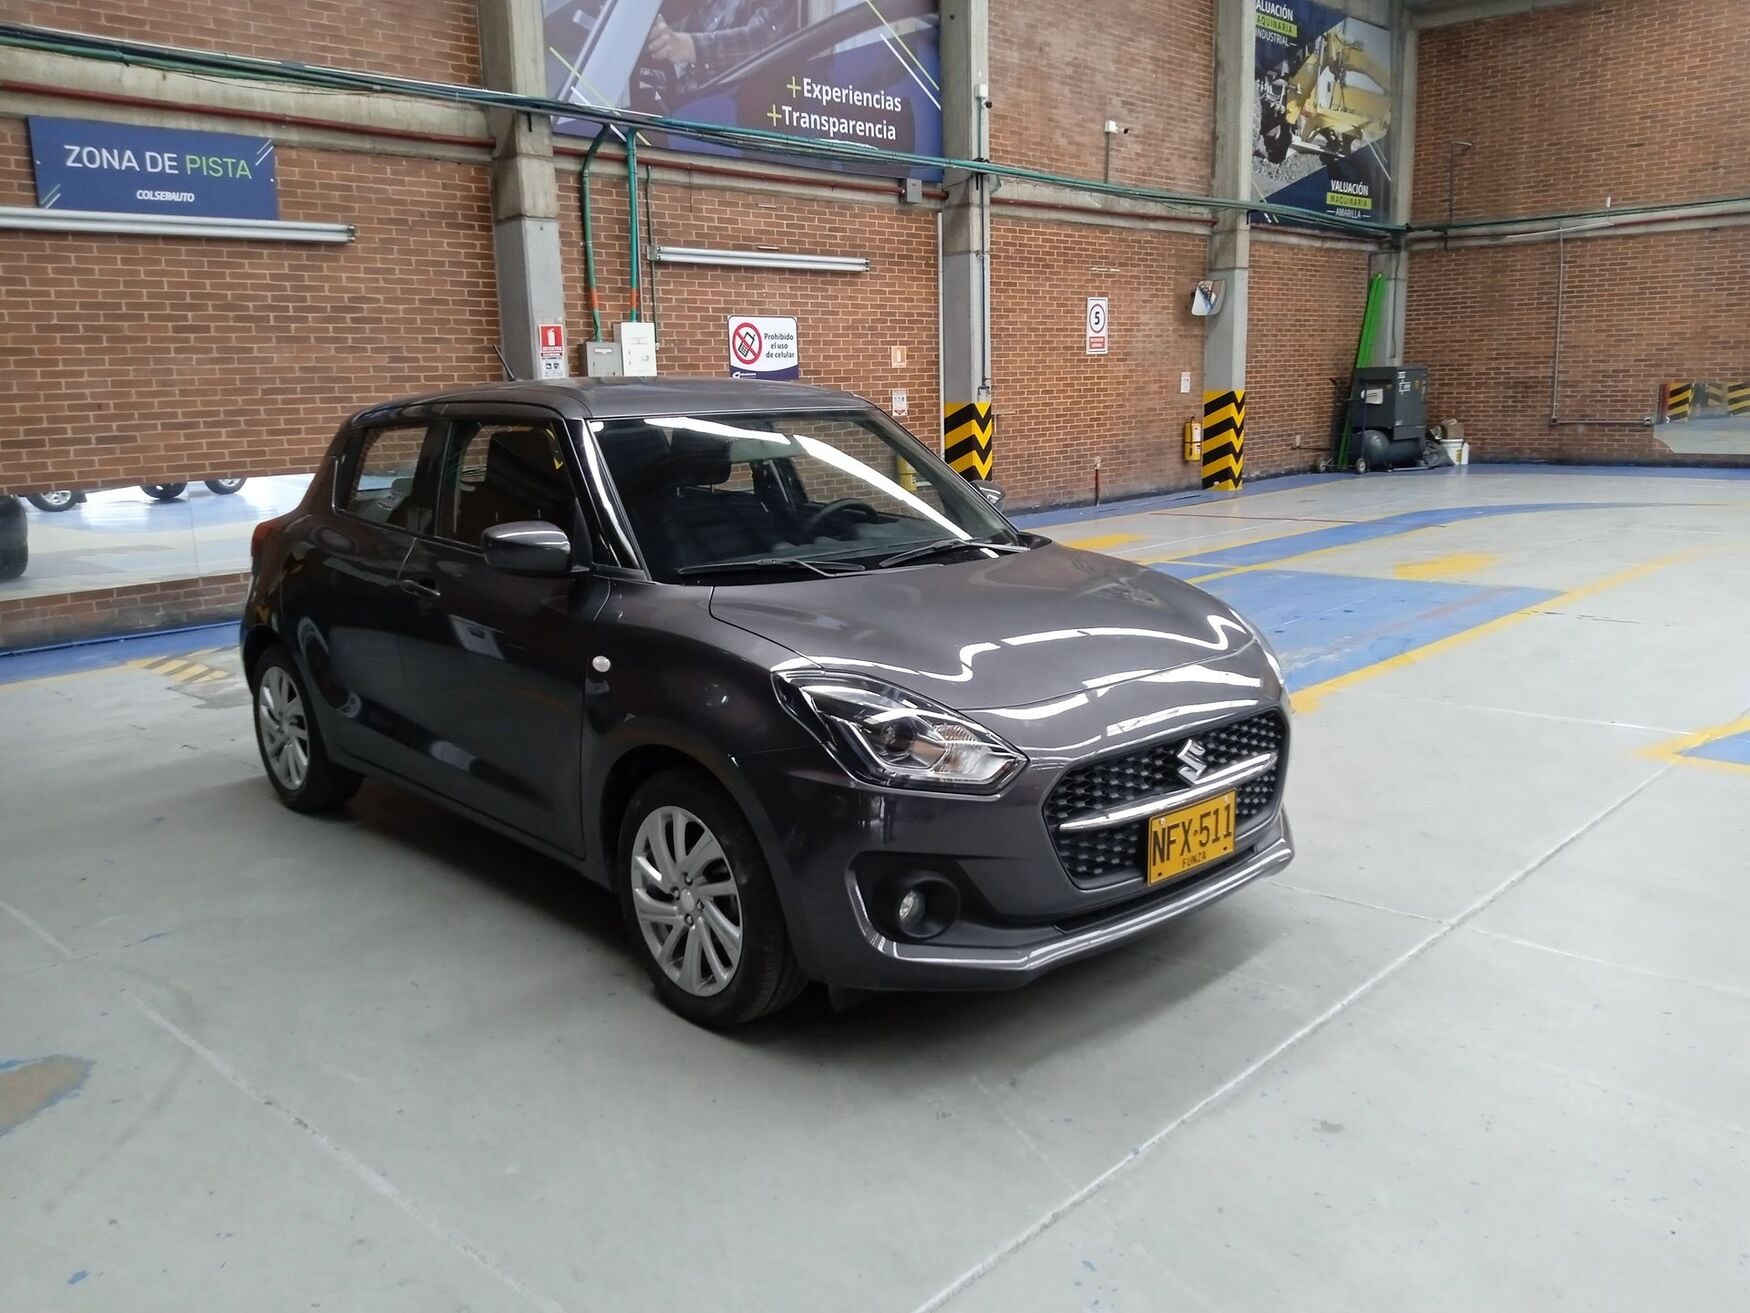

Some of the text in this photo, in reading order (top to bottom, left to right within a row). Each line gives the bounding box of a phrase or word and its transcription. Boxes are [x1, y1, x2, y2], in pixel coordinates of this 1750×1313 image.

[1256, 0, 1294, 21] ALUACIÓN
[1256, 14, 1293, 33] AQUINARIA
[63, 144, 252, 179] ZONA DE PISTA
[1330, 179, 1369, 196] VALUACIÓN
[136, 189, 195, 203] COLSERAUTO
[1094, 311, 1100, 326] 5
[764, 332, 794, 341] Prohibido
[765, 351, 795, 360] de celular
